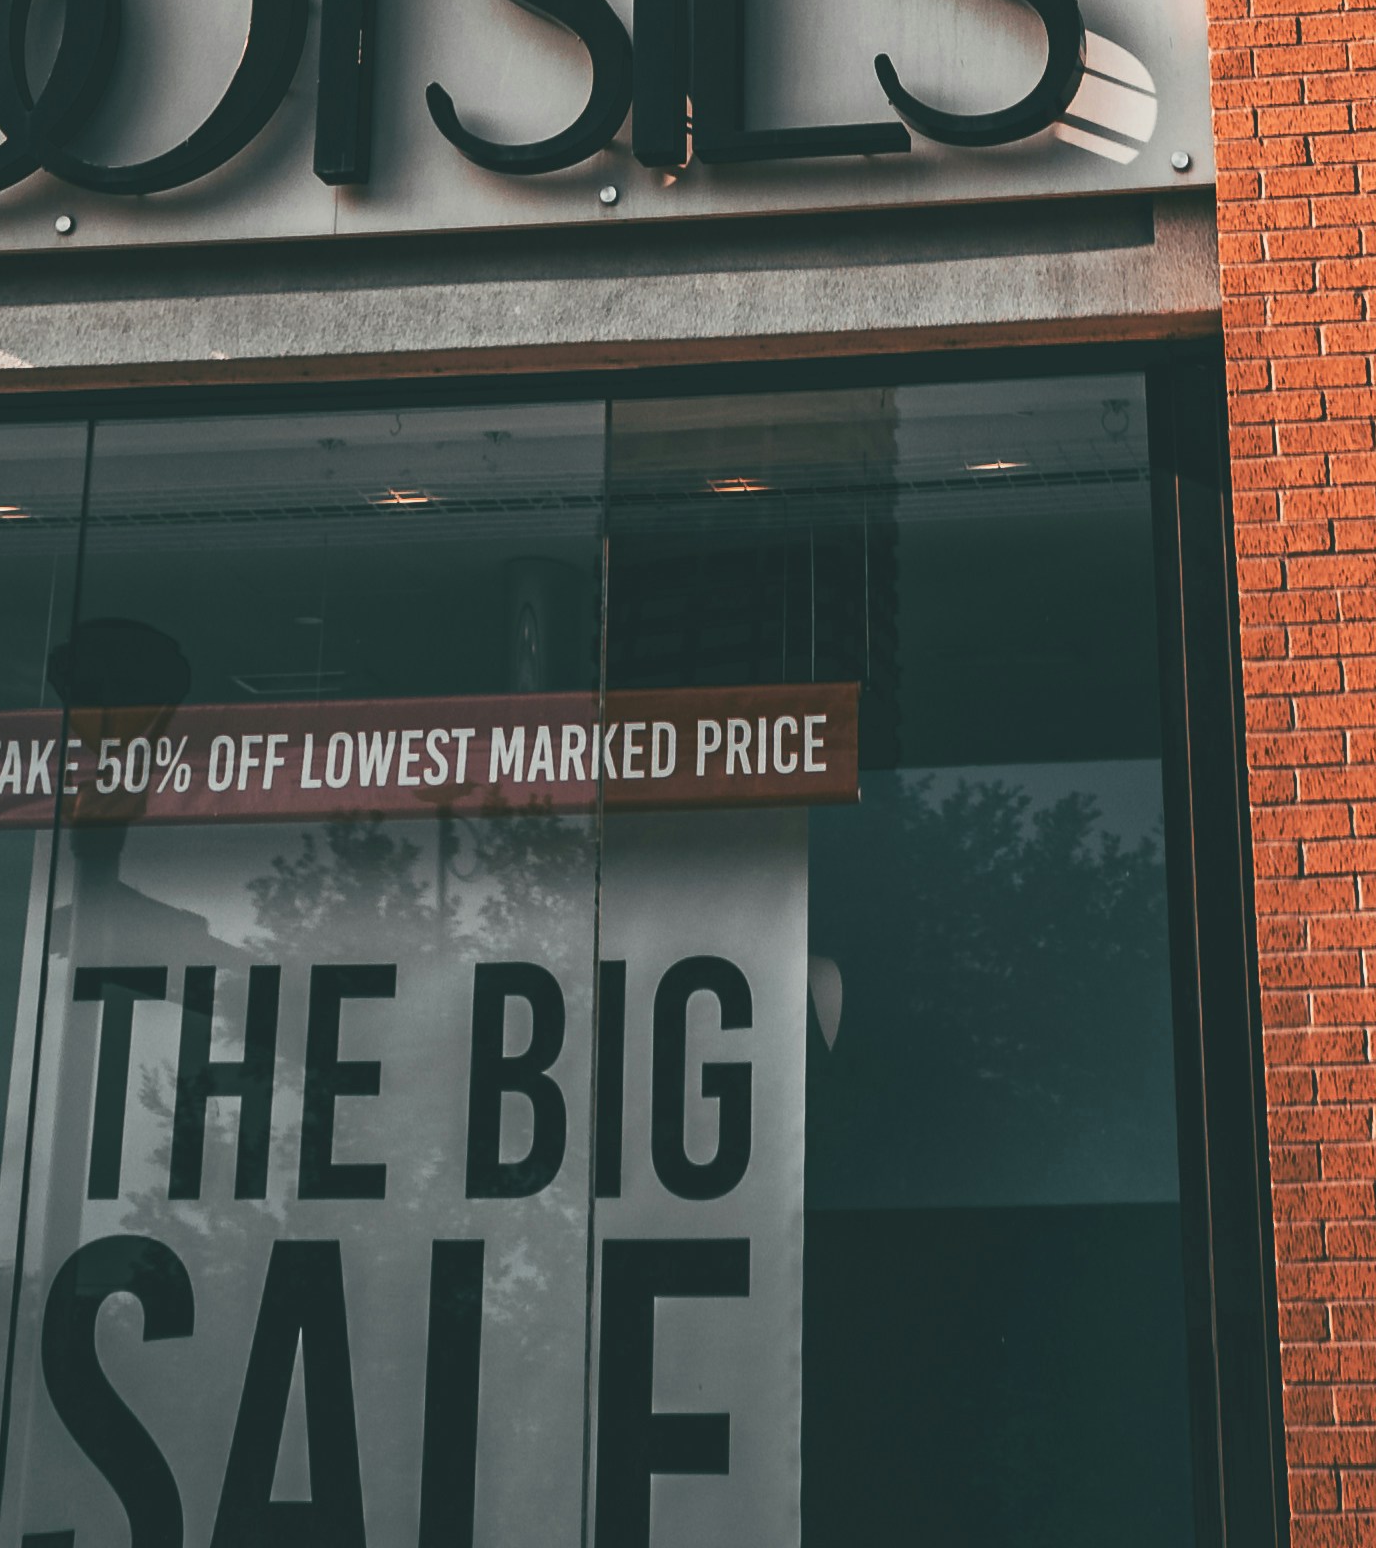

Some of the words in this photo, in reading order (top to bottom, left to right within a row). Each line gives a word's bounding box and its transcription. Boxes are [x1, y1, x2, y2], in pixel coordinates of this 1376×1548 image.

[95, 734, 192, 794] 50%
[207, 732, 288, 793] OFF
[298, 727, 476, 790] LOWEST
[487, 721, 677, 784] MARKED
[694, 714, 828, 777] PRICE
[71, 962, 398, 1201] THE
[464, 953, 754, 1202] BIG
